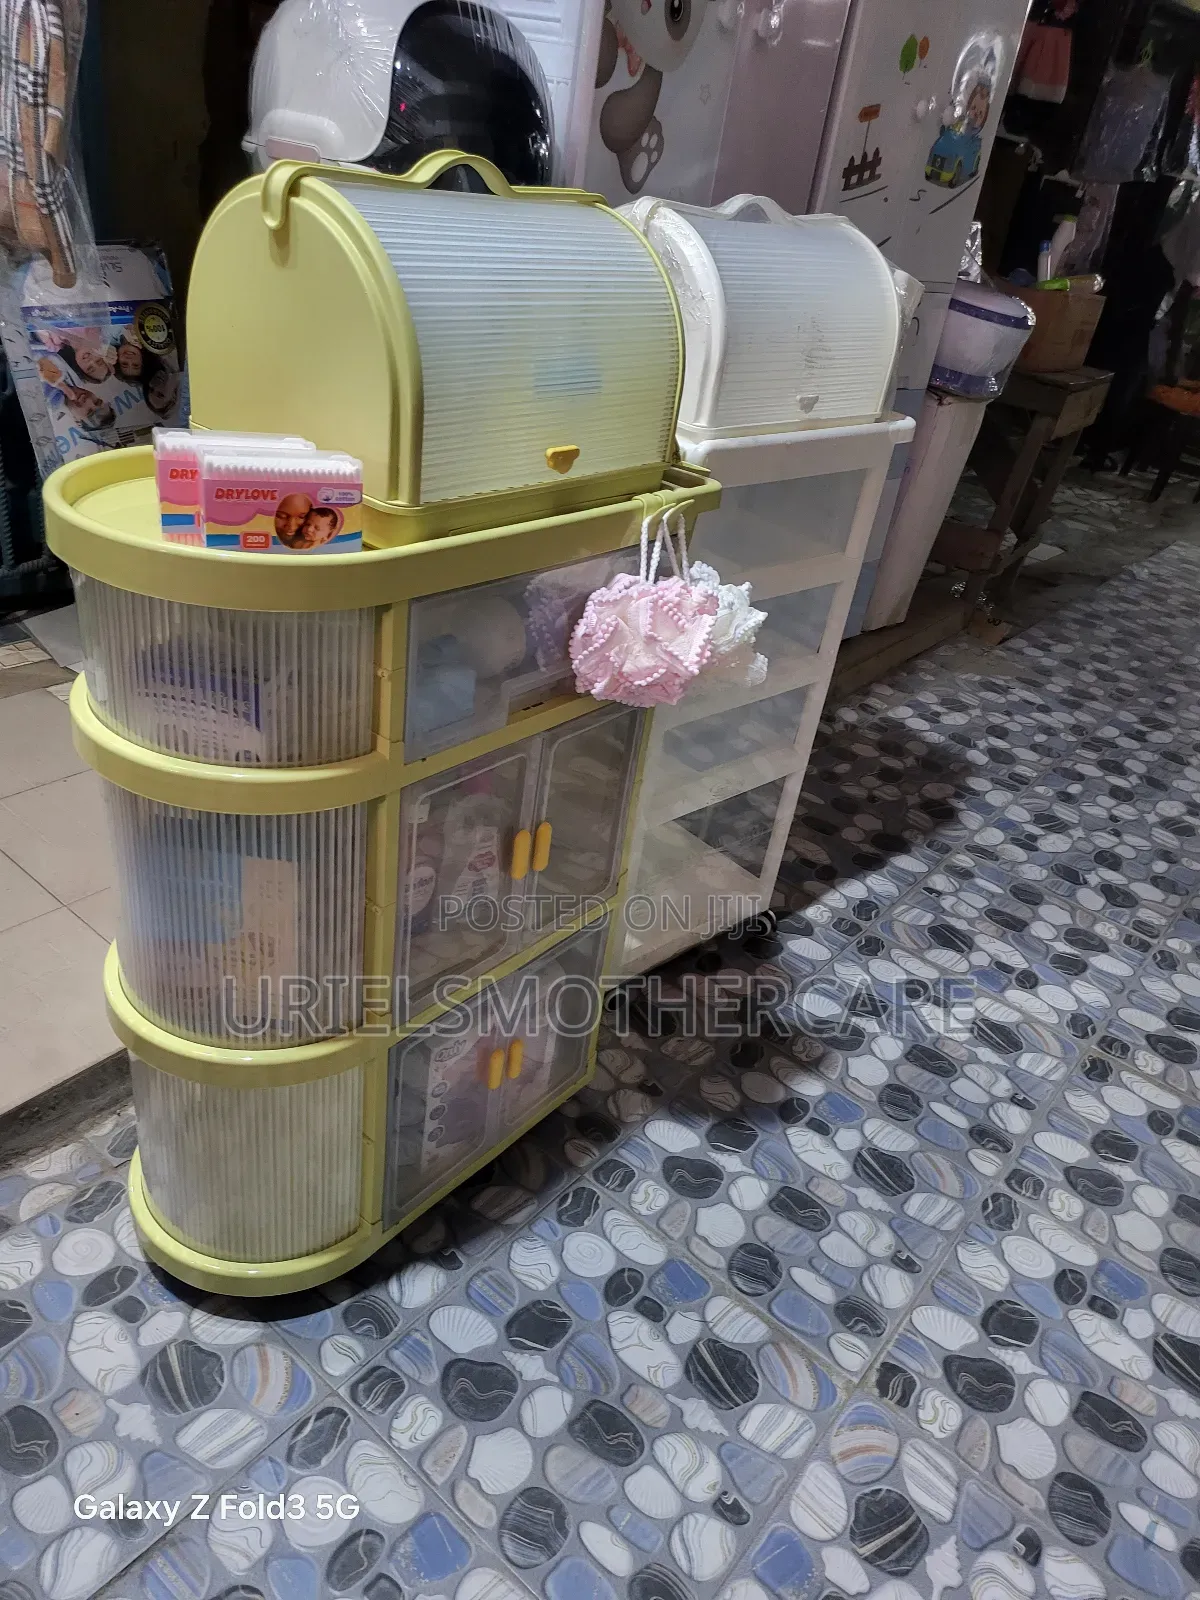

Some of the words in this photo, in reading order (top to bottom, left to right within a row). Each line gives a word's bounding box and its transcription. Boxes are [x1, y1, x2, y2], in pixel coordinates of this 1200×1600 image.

[145, 323, 165, 333] 100%
[214, 487, 278, 501] DRYLOVE
[246, 535, 266, 543] 200
